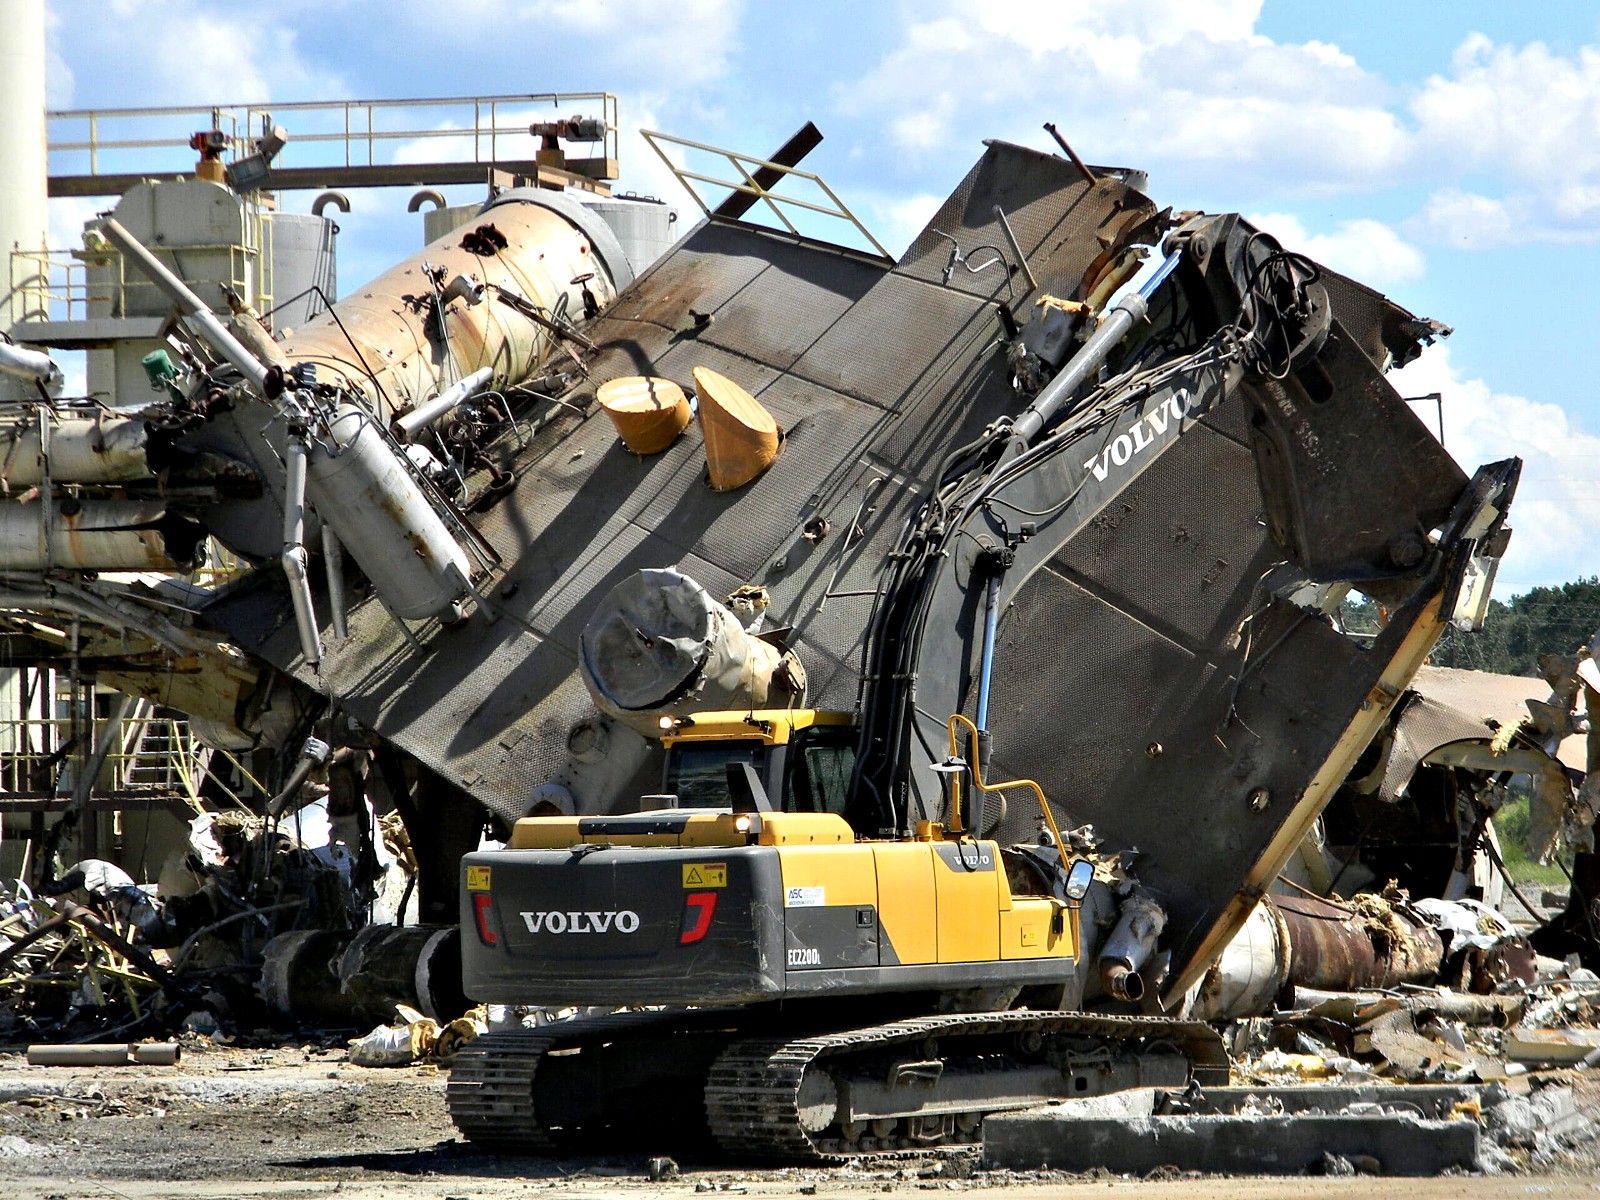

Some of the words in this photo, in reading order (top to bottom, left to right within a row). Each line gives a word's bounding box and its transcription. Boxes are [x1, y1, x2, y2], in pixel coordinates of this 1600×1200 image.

[1083, 387, 1192, 482] VOLVO
[789, 888, 803, 899] ASC
[519, 910, 640, 934] VOLVO
